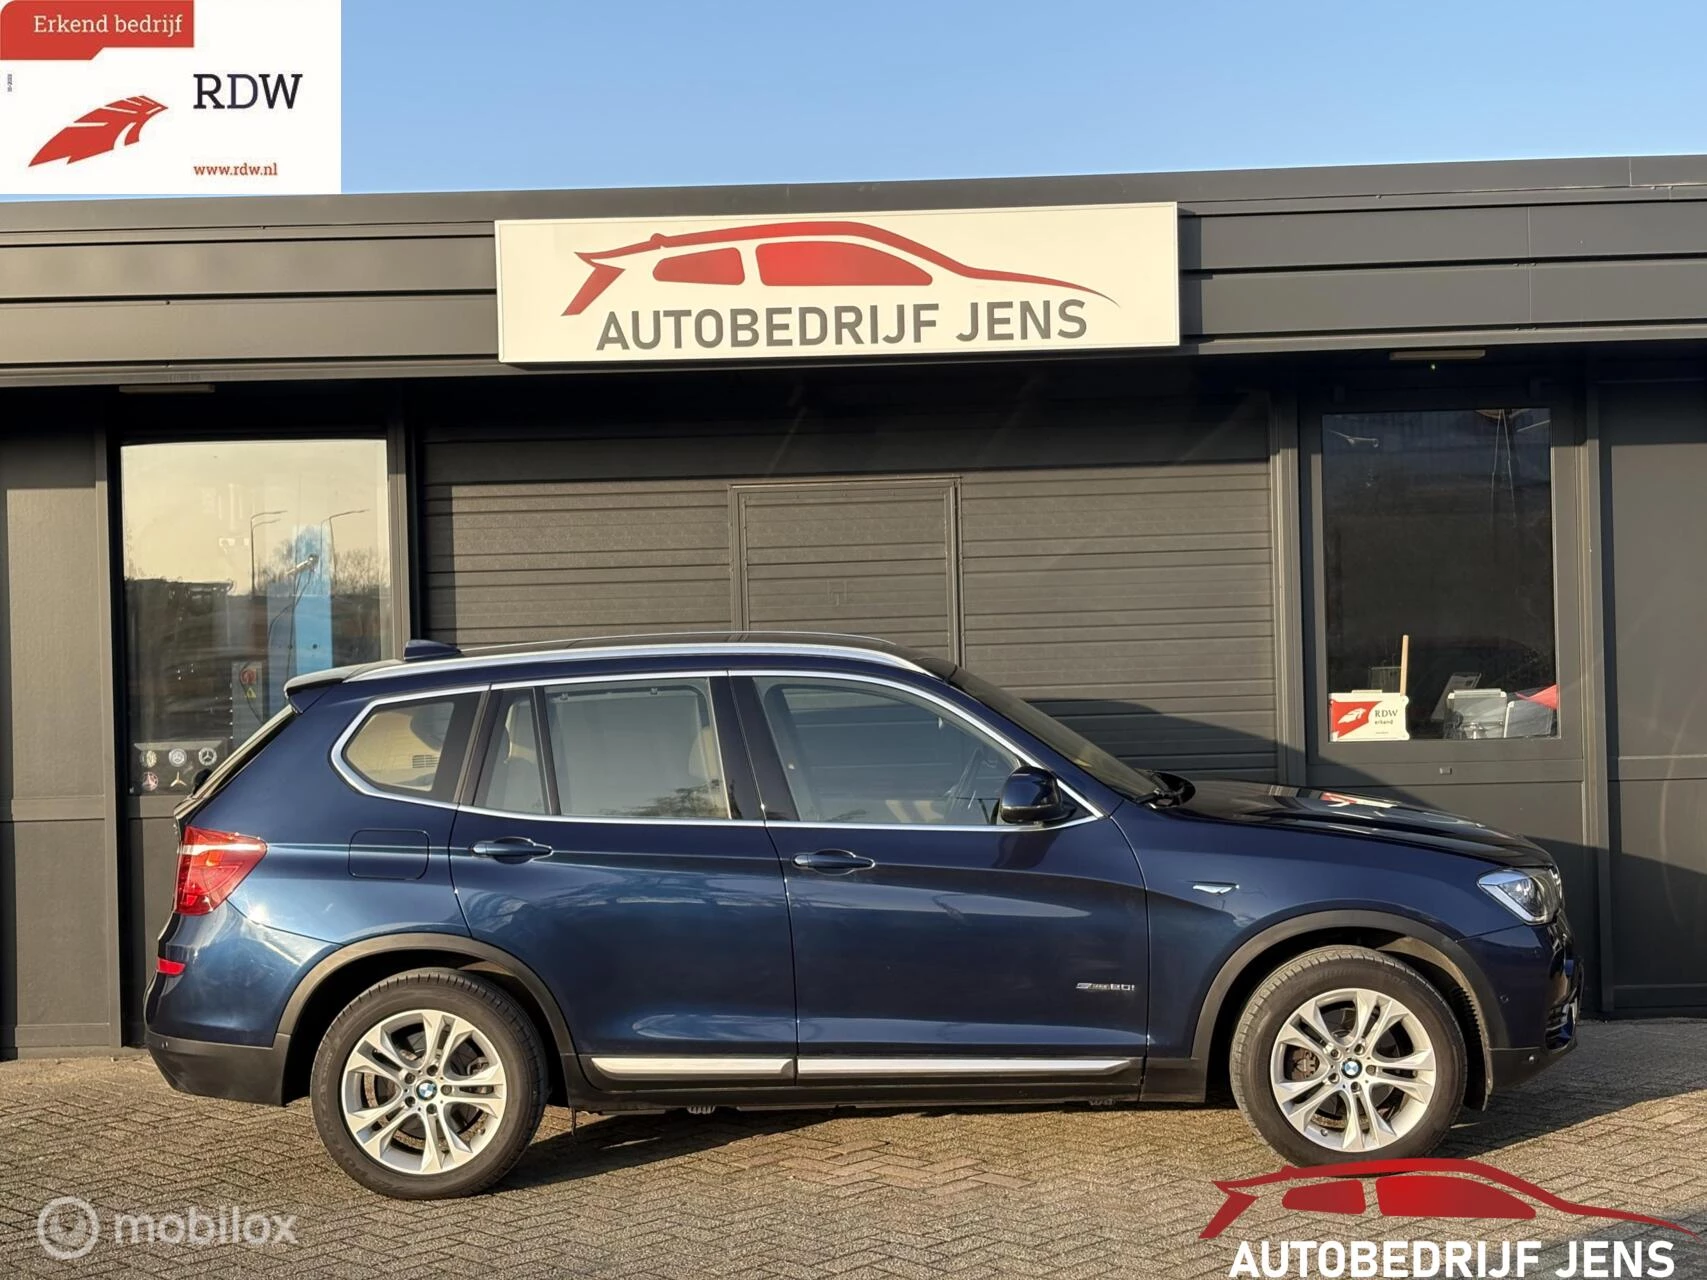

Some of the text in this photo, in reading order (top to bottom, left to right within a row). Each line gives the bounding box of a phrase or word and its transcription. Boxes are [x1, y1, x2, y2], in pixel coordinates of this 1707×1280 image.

[596, 298, 1088, 351] AUTOBEDRIJF JENS
[1374, 709, 1398, 718] RDW
